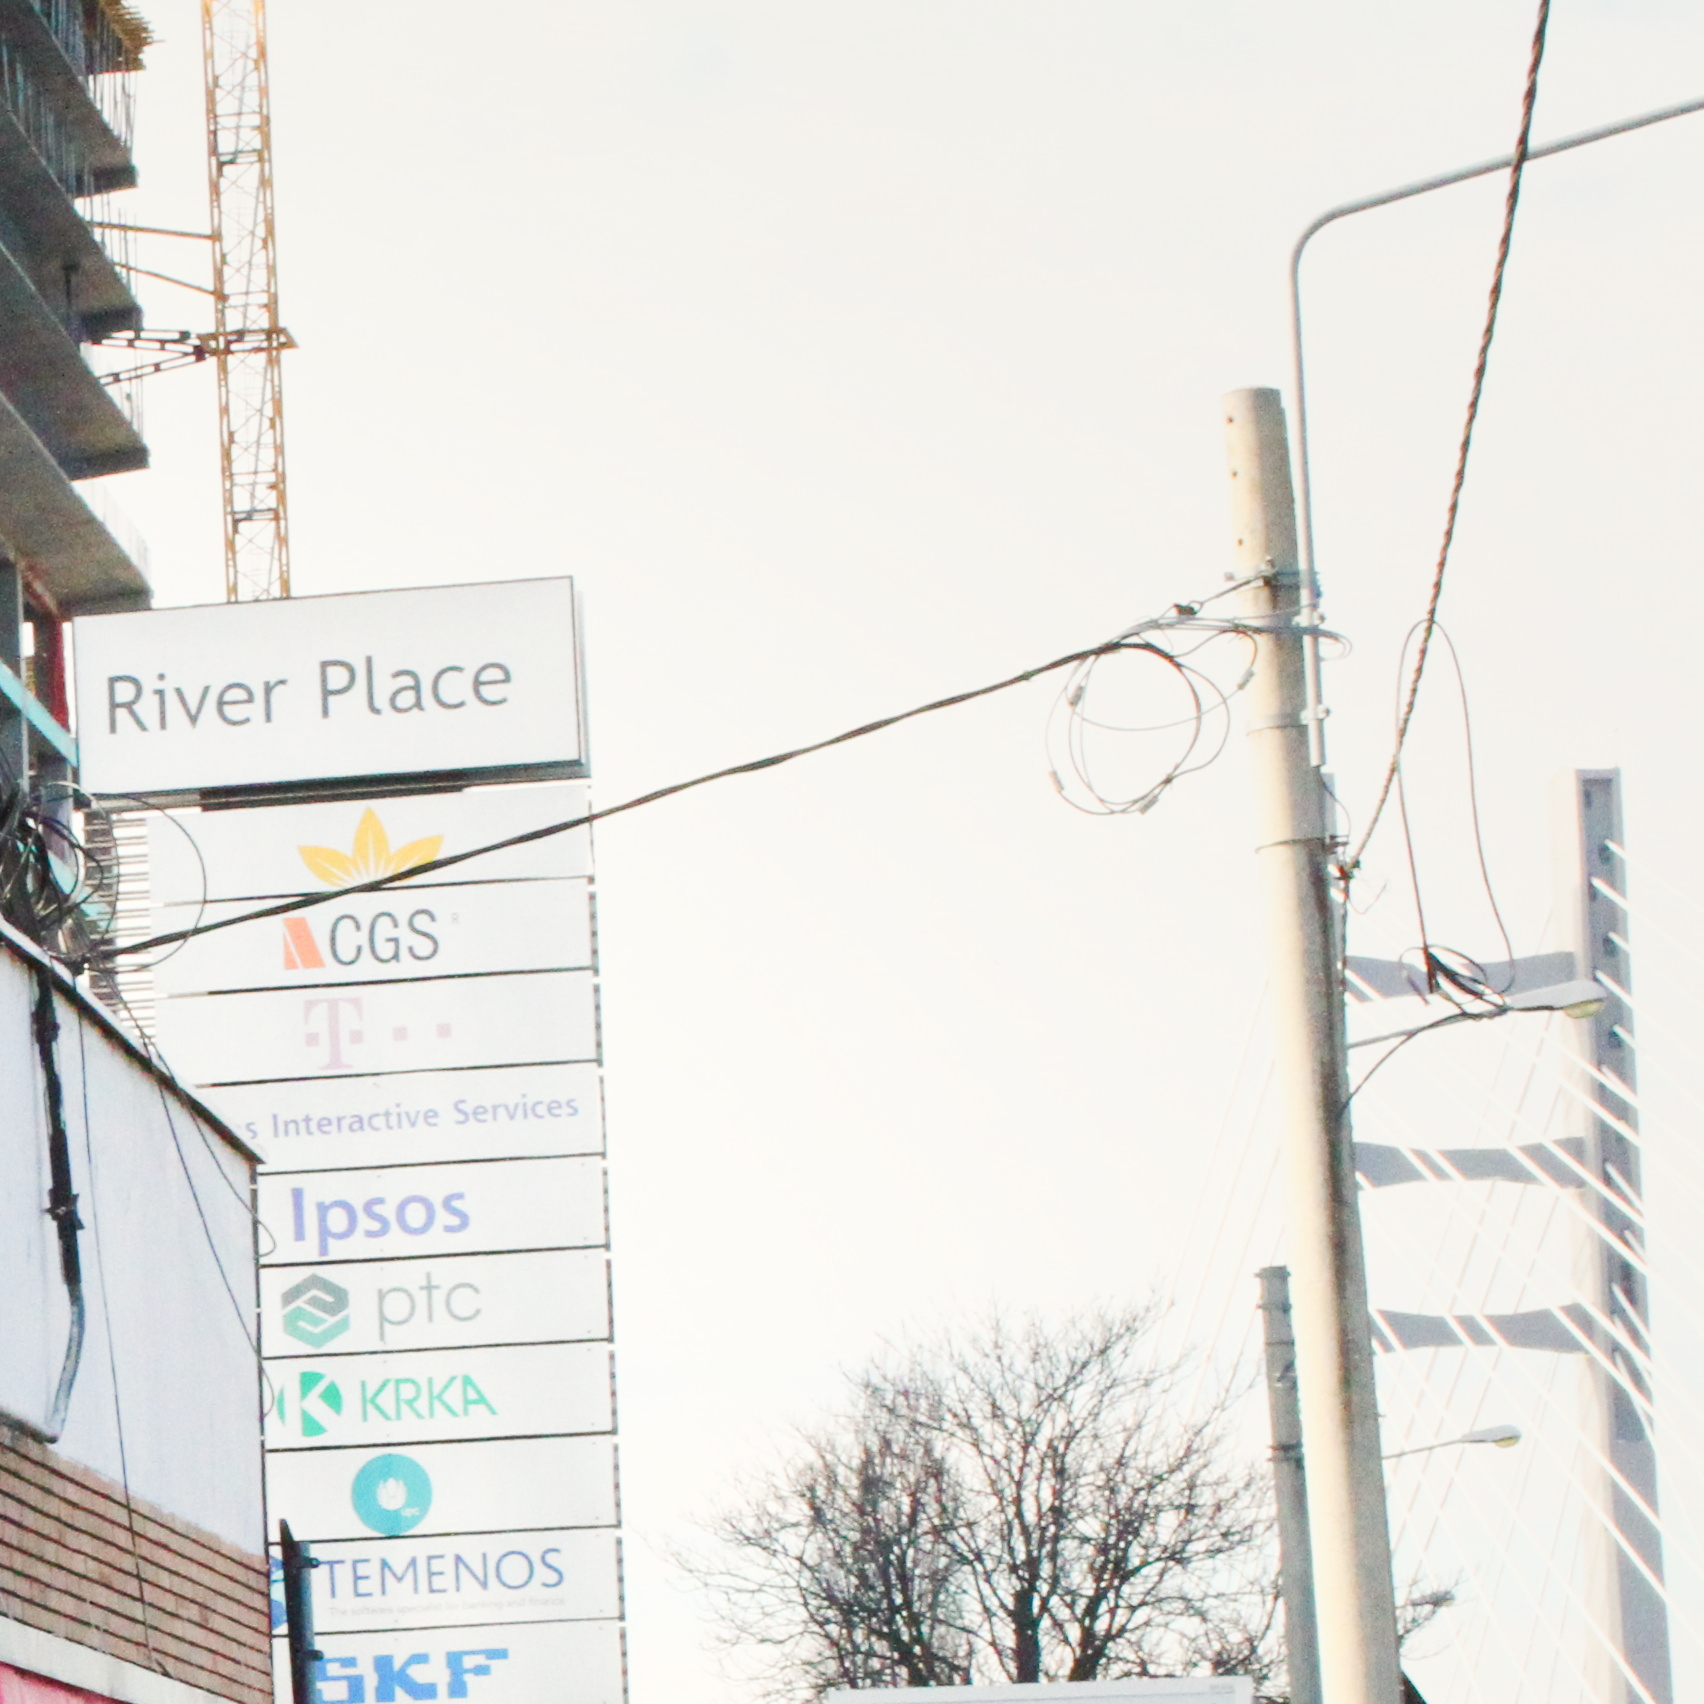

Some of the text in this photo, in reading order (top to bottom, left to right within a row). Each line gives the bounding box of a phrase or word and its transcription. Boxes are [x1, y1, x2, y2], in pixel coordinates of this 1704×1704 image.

[106, 655, 512, 735] River Place
[329, 908, 440, 967] CGS
[271, 1102, 440, 1139] Interactive
[452, 1092, 580, 1125] Services
[290, 1184, 471, 1256] Ipsos
[377, 1271, 483, 1343] ptc
[360, 1373, 498, 1423] KRKA
[324, 1547, 566, 1600] TEMENOS
